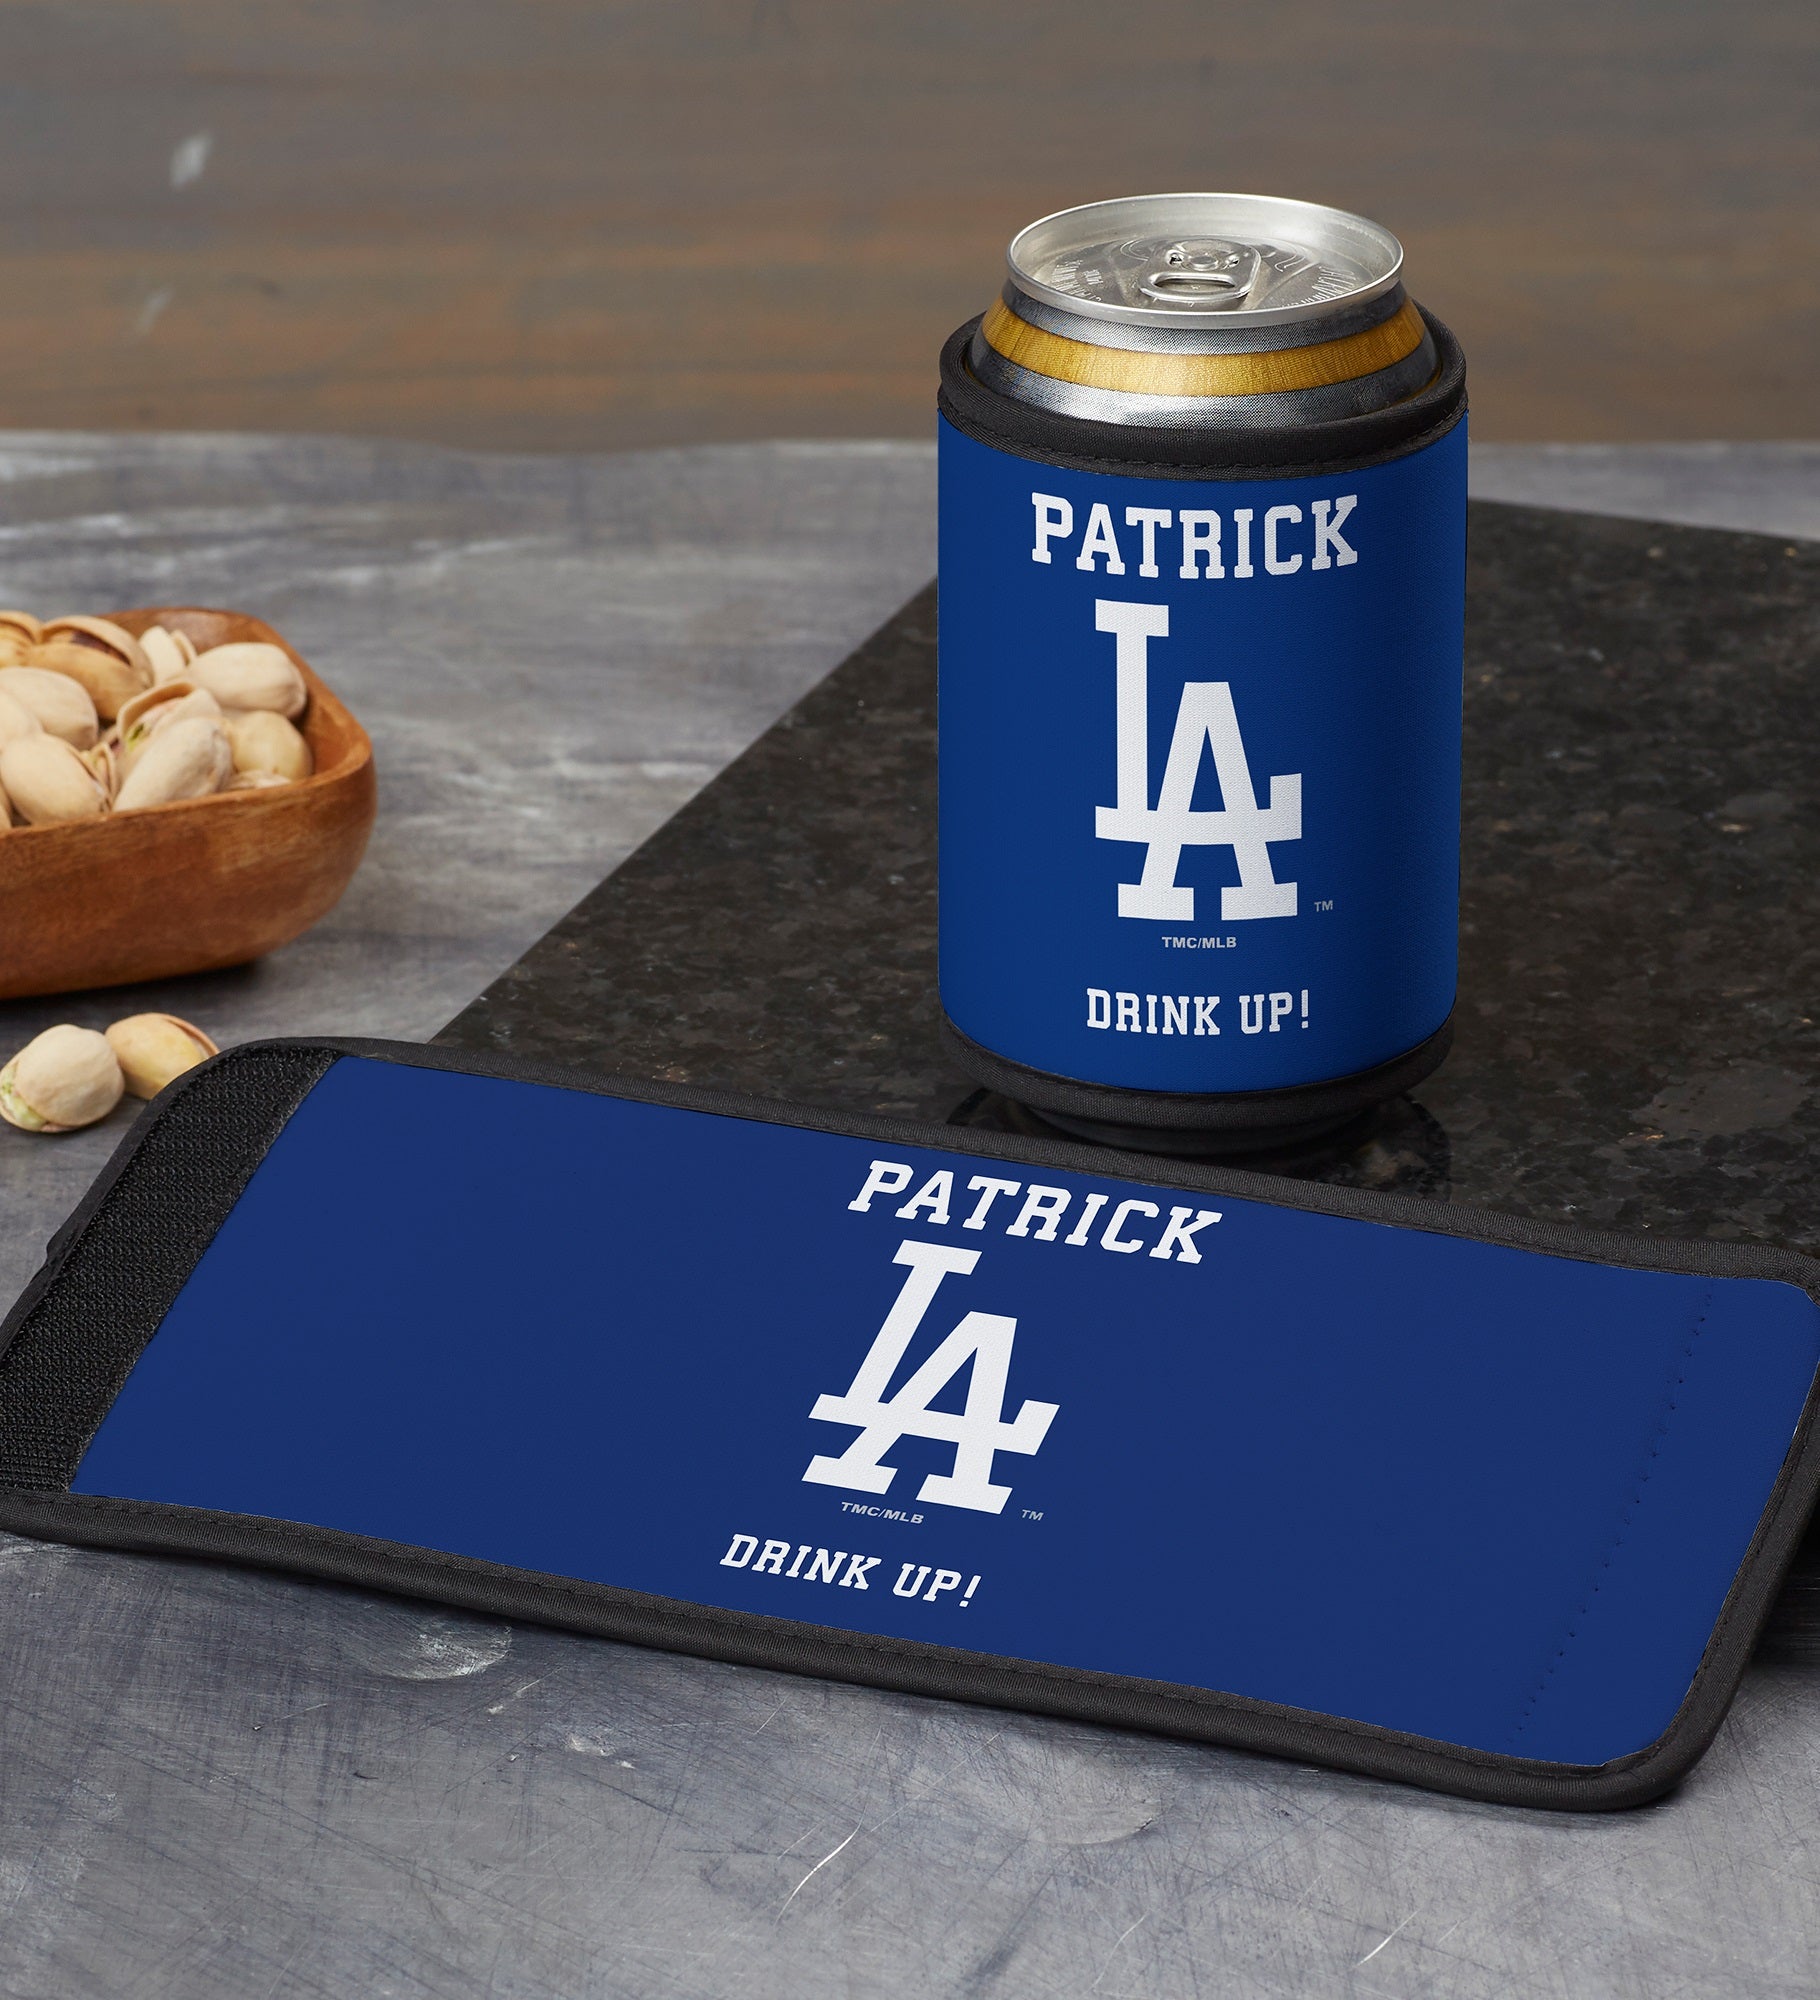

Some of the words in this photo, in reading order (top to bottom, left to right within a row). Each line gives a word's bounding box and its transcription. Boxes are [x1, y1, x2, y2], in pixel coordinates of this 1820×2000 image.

[1031, 491, 1358, 580] PATRICK
[1094, 598, 1303, 922] LA
[1314, 900, 1334, 912] TM
[1161, 936, 1238, 949] TMC/MLB
[1086, 987, 1221, 1036] DRINK
[1238, 989, 1310, 1036] UP!
[847, 1159, 1223, 1265] PATRICK
[801, 1239, 1061, 1515] LA
[840, 1501, 925, 1525] TMC/MLB
[1021, 1509, 1045, 1522] TM
[719, 1533, 883, 1591] DRINK
[892, 1562, 983, 1608] UP!
